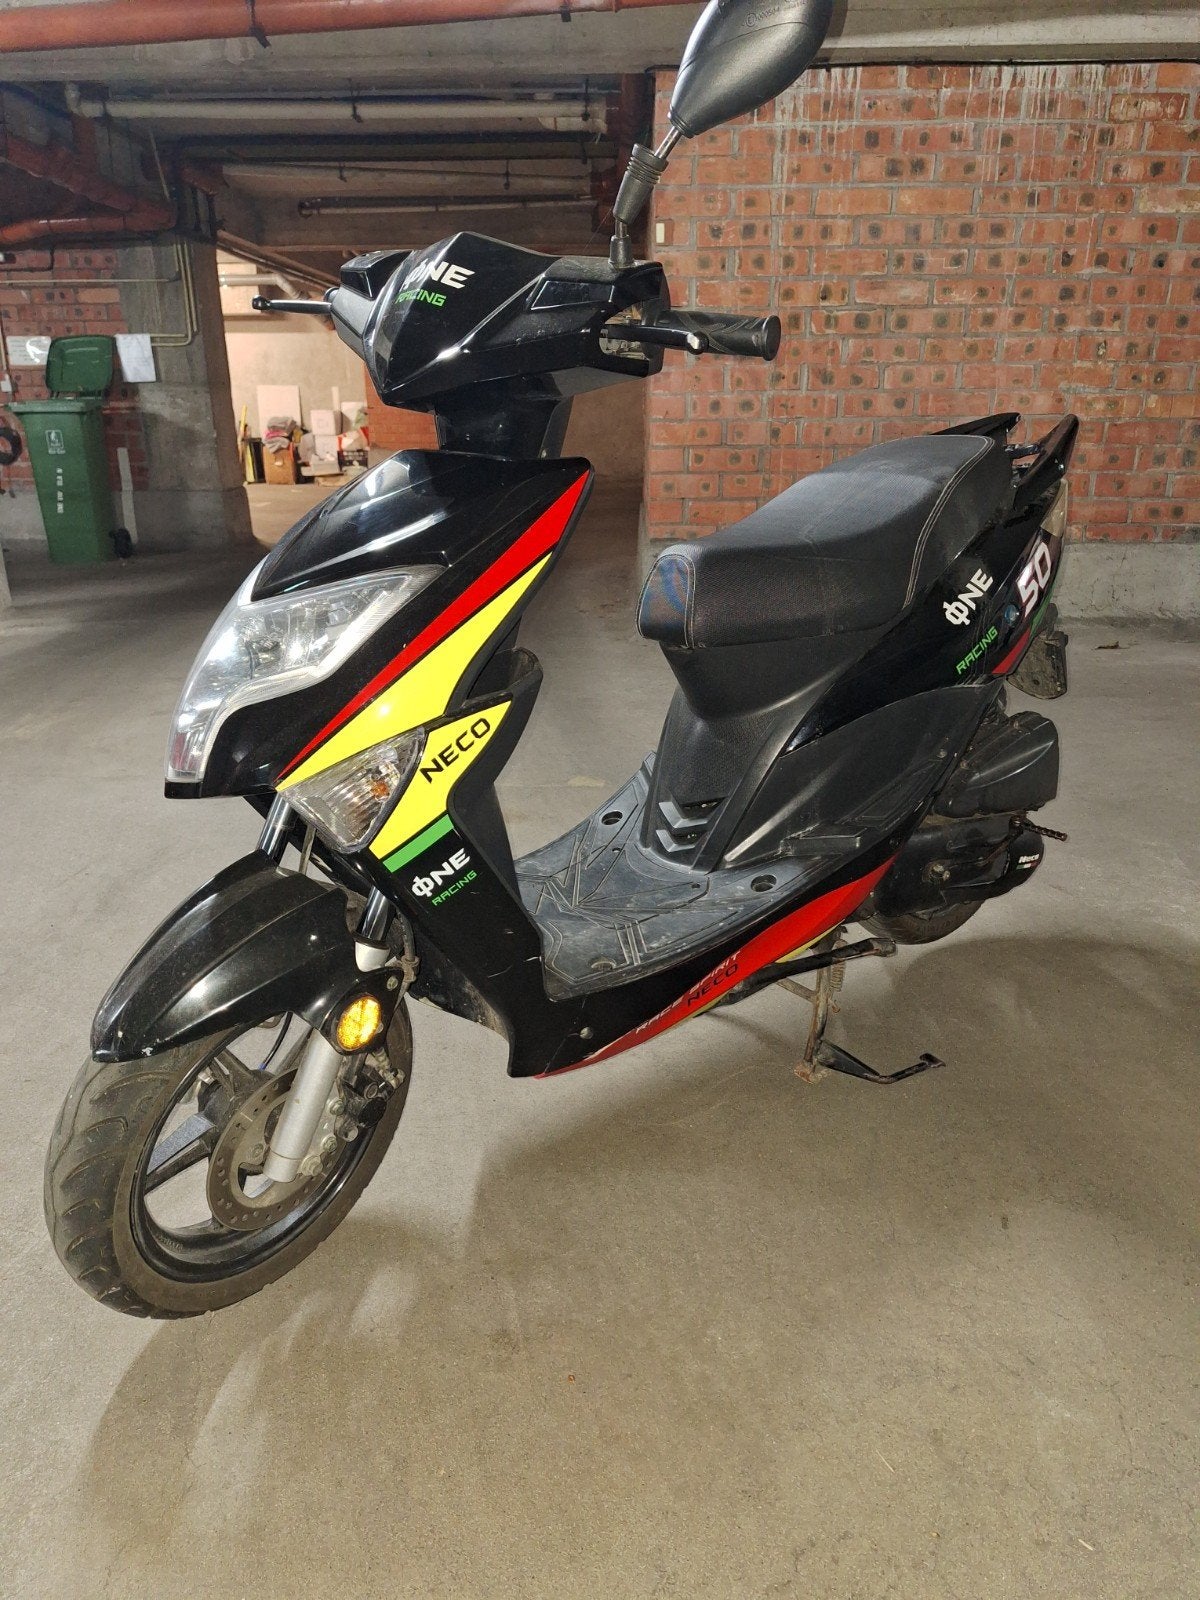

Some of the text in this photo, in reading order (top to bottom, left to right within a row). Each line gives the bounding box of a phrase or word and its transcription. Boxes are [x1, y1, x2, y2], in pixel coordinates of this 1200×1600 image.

[1016, 541, 1052, 619] 50
[955, 625, 998, 675] RACING
[419, 717, 491, 784] NECO
[431, 869, 478, 907] RACING
[686, 963, 739, 1008] NECO
